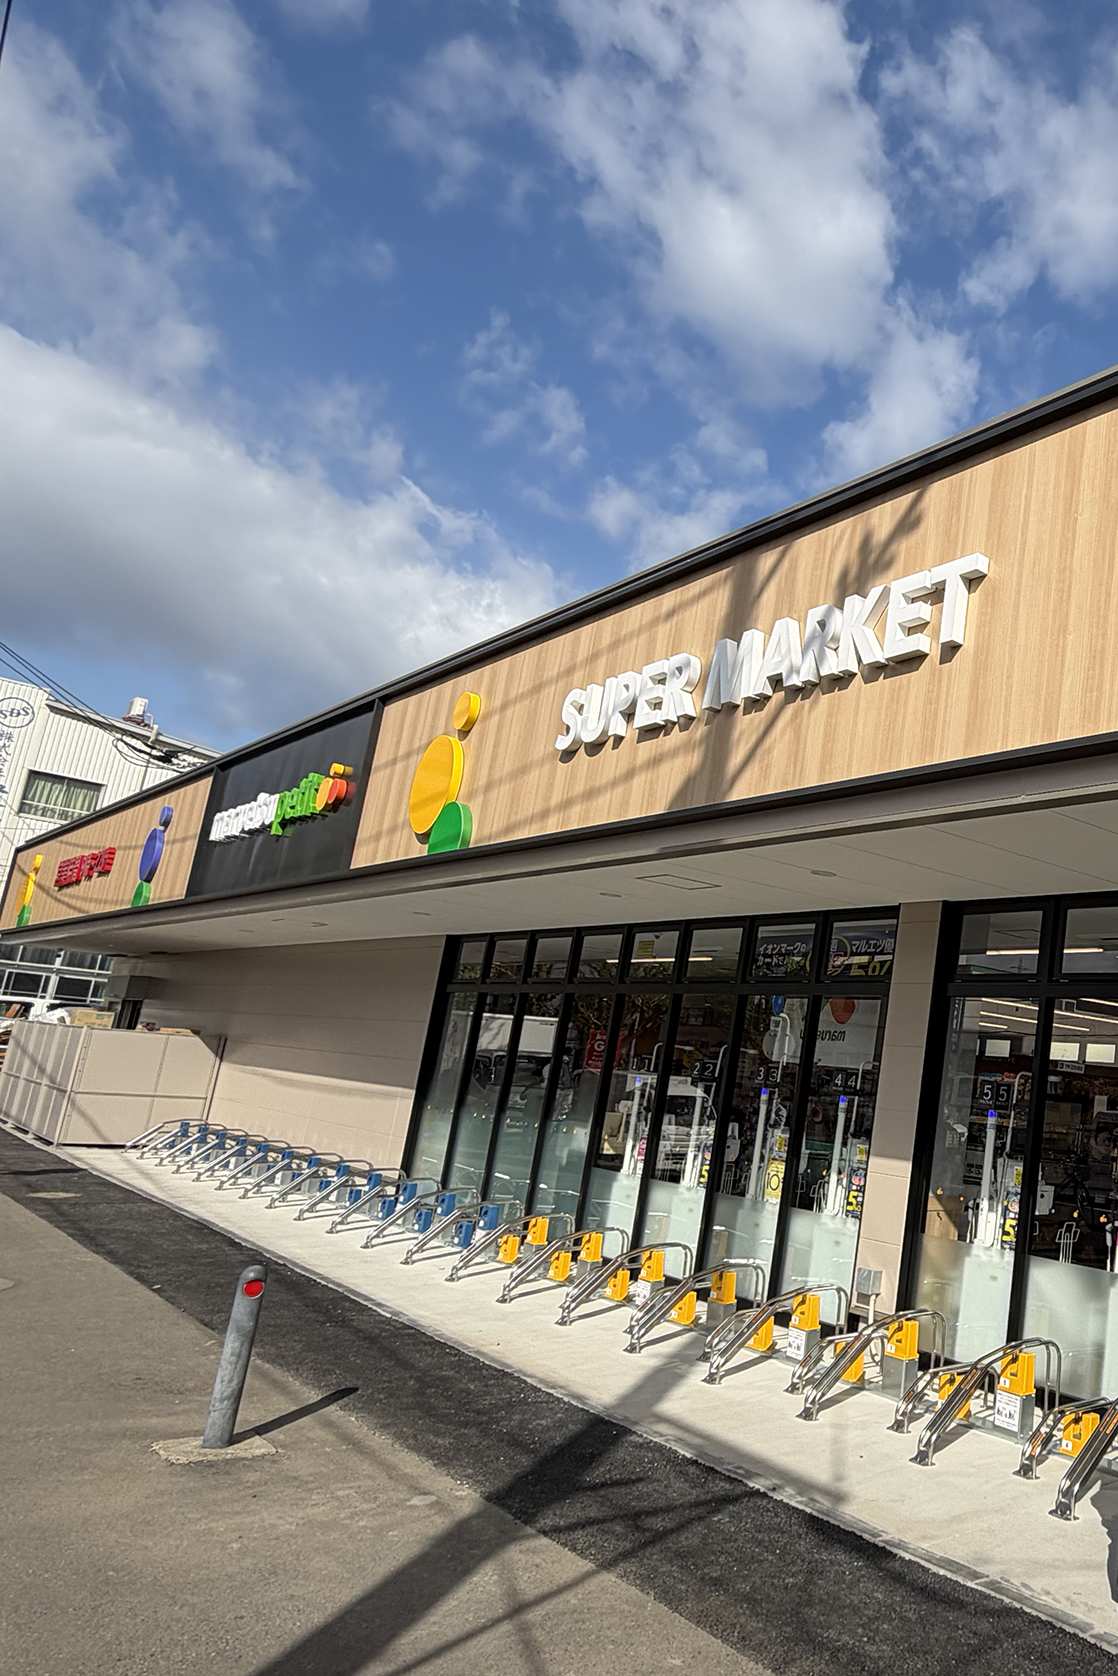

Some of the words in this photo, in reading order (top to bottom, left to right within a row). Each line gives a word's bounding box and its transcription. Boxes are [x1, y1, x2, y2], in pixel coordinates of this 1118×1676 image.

[555, 652, 702, 752] SUPER
[702, 551, 989, 711] MARKET
[693, 1062, 701, 1075] 2
[704, 1064, 714, 1076] 2
[757, 1067, 764, 1080] 3
[834, 1073, 842, 1086] 4
[848, 1076, 856, 1087] 4
[983, 1084, 992, 1100] 5
[998, 1086, 1008, 1101] 5
